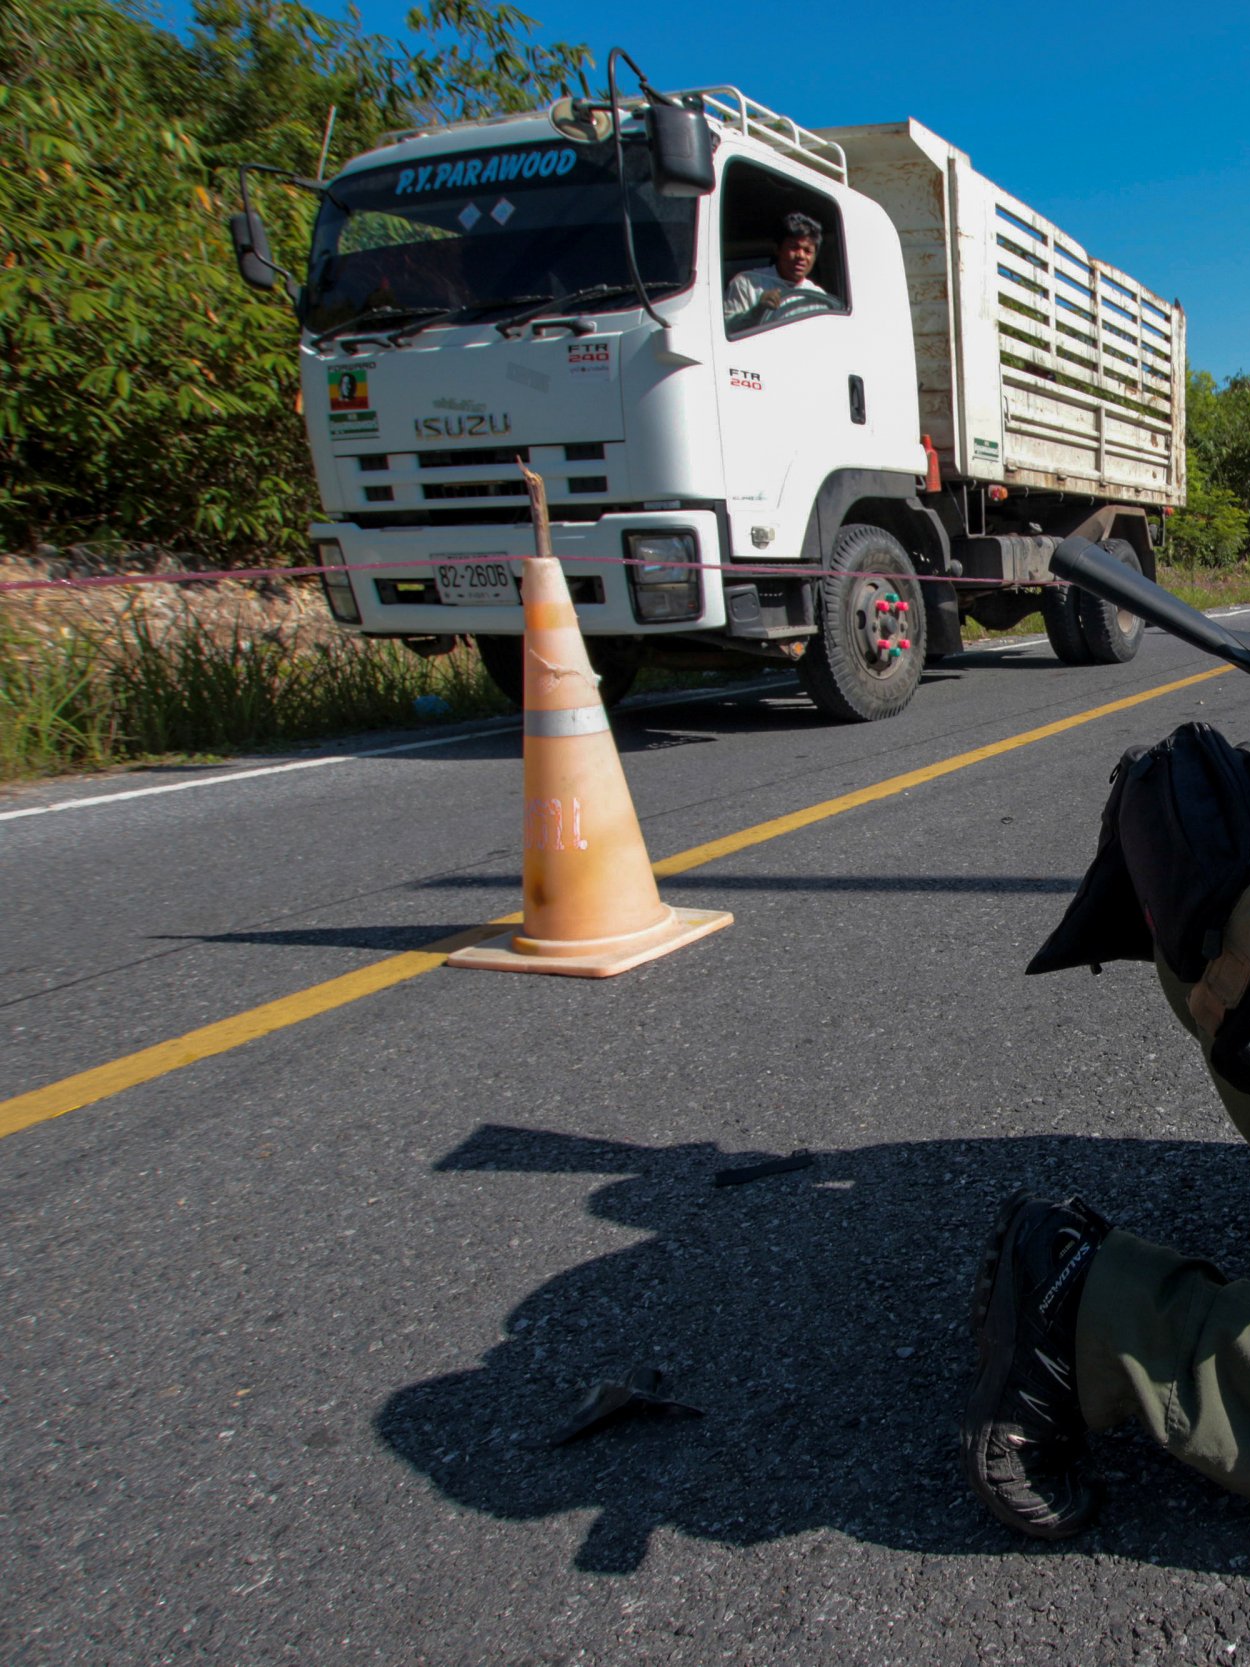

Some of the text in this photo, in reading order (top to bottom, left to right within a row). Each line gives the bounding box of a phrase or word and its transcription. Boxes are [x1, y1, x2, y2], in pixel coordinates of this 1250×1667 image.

[568, 343, 608, 353] FTR
[568, 352, 609, 363] 240
[729, 368, 761, 381] FTR
[730, 378, 762, 390] 240
[414, 413, 512, 440] ISUZU
[438, 563, 508, 588] 82-2606
[1039, 1242, 1090, 1314] SALOMON
